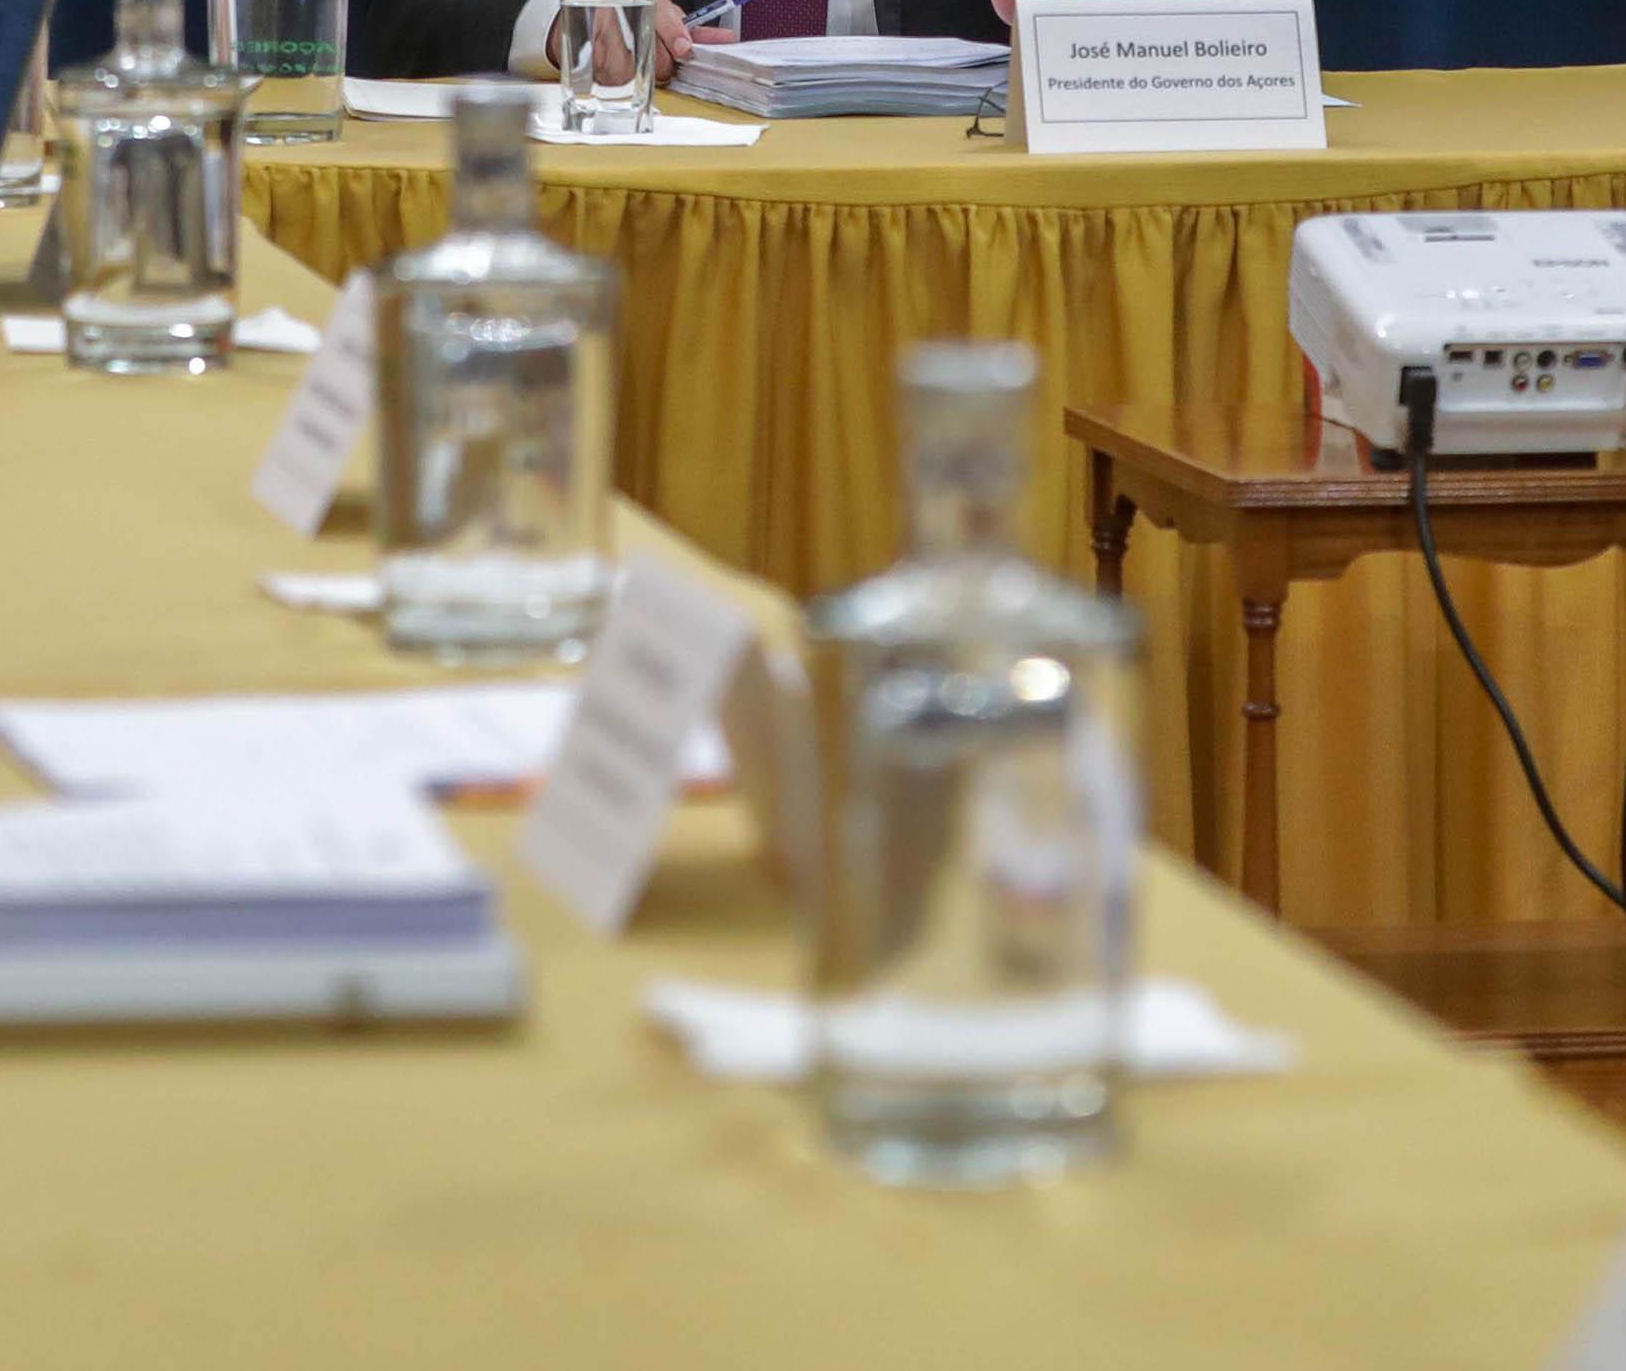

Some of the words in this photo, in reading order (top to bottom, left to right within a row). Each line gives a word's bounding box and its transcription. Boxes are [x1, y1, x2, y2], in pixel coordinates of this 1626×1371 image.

[1070, 41, 1111, 59] José
[1116, 41, 1189, 59] Manuel
[1194, 39, 1268, 58] Bolieiro
[1047, 76, 1126, 90] Presidente
[1128, 76, 1149, 90] do
[1151, 75, 1214, 90] Governo
[1216, 74, 1244, 89] dos
[1246, 74, 1296, 90] Açores
